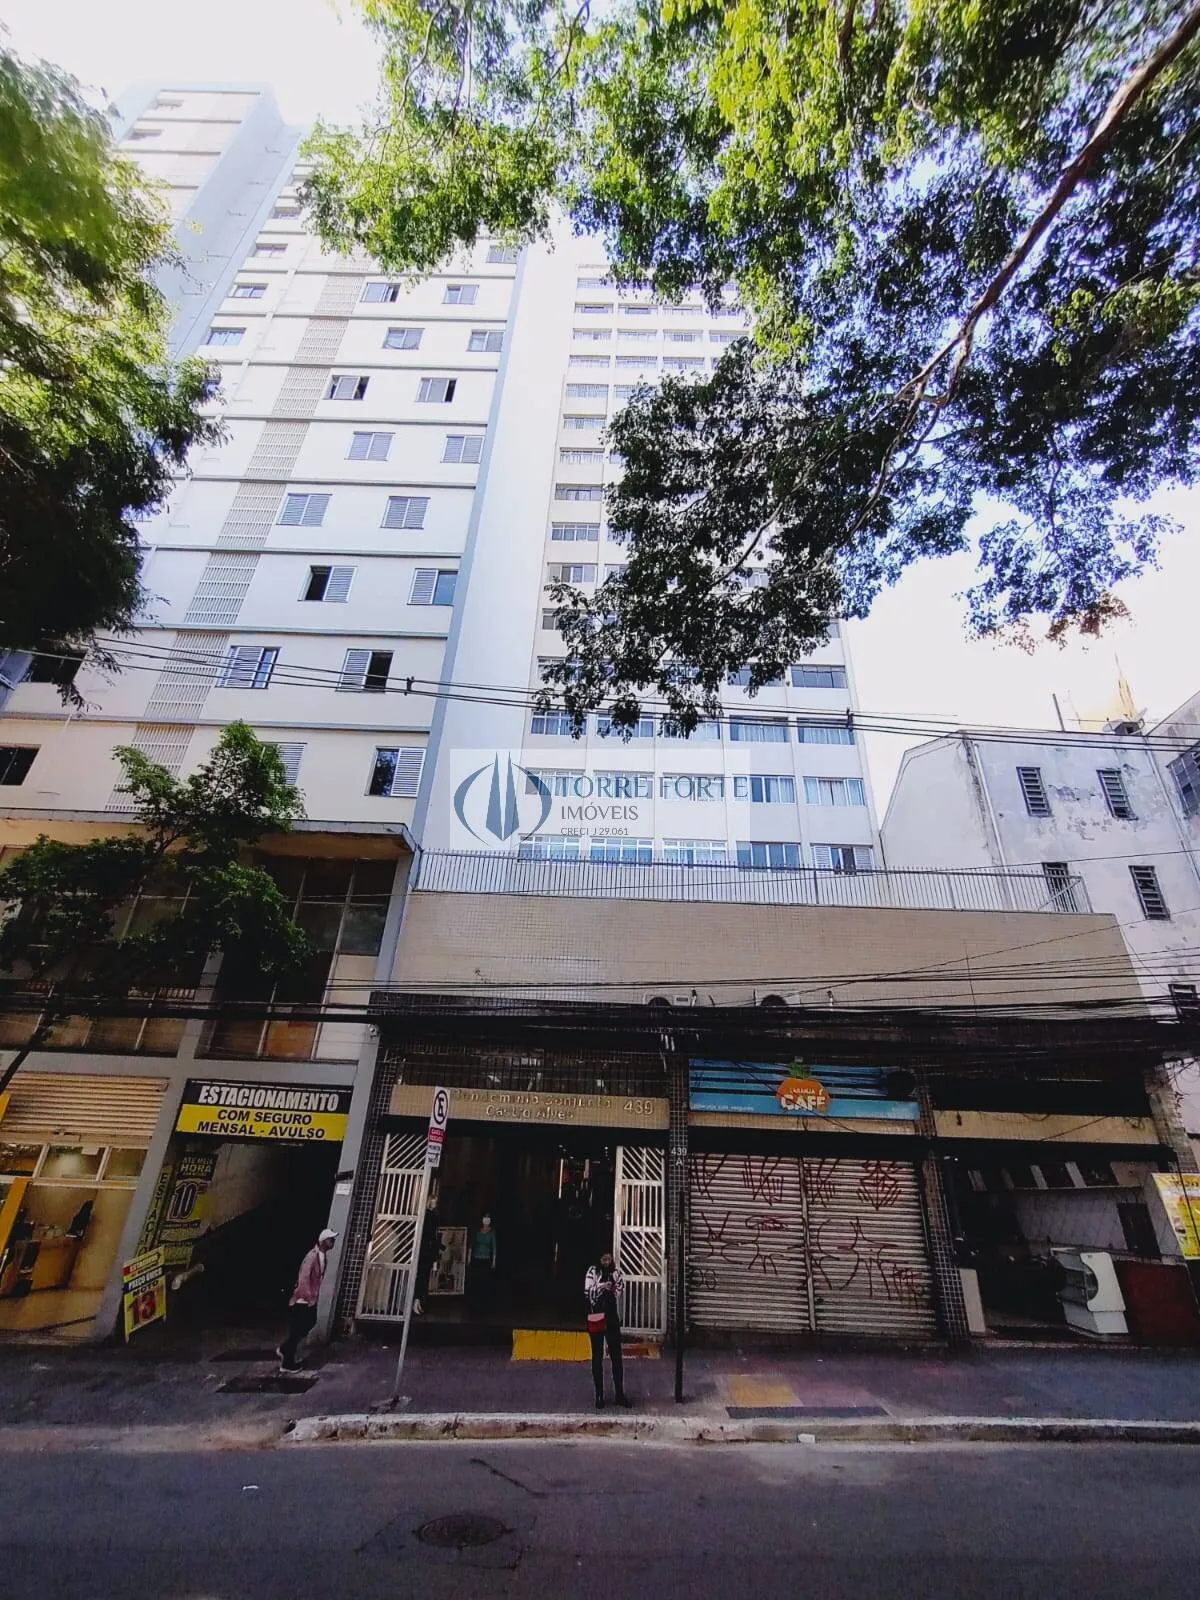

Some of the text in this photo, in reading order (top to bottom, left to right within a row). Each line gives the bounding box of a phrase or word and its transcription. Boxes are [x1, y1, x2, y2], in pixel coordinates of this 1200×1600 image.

[198, 1085, 340, 1112] ESTACIONAMENTO
[624, 1099, 654, 1115] 439
[217, 1109, 312, 1125] COM SEGURO
[197, 1121, 256, 1135] MENSAL
[269, 1126, 326, 1139] AVULSO
[180, 1164, 212, 1173] HORA
